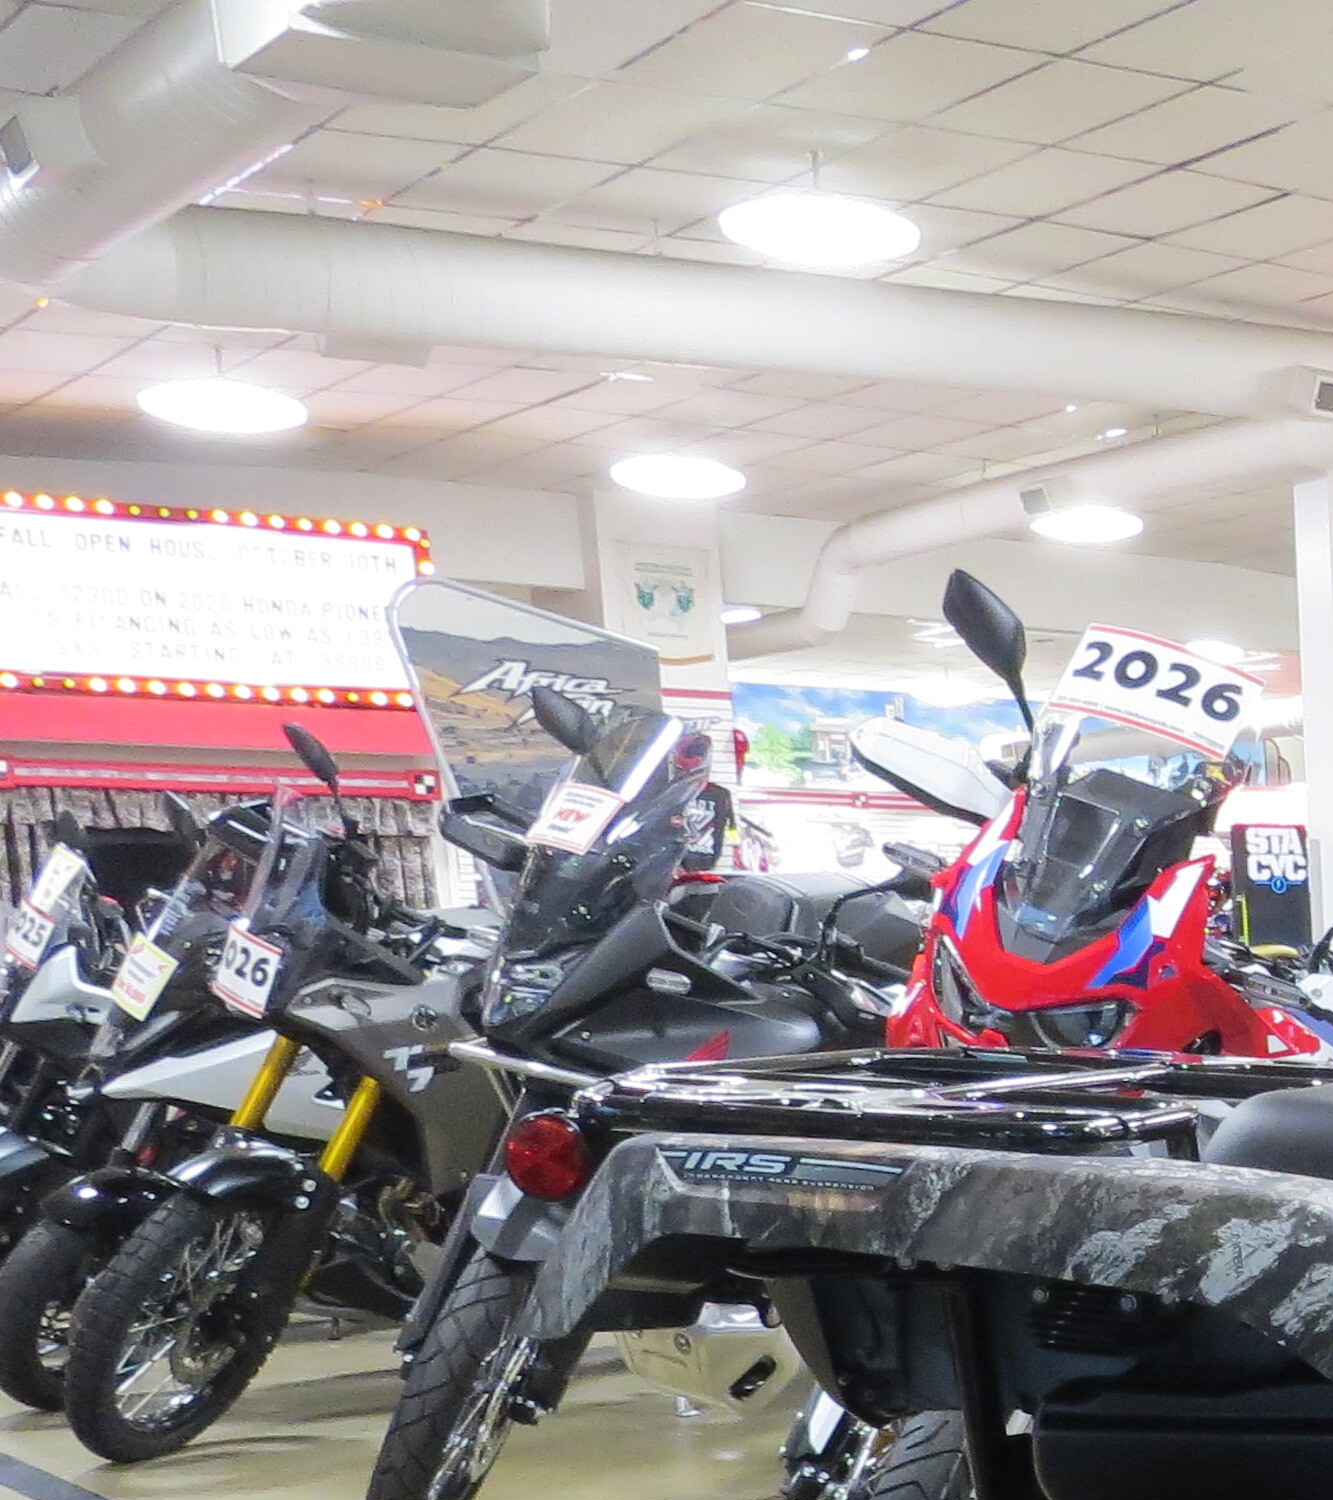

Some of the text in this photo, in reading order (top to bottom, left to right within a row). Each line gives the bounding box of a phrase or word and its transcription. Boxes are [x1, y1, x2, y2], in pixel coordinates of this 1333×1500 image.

[76, 532, 131, 555] OPEN
[149, 537, 216, 561] HOUS
[238, 545, 333, 570] OTOBER
[141, 589, 168, 608] ON
[243, 596, 312, 619] HONDA
[322, 601, 383, 624] PIONE
[75, 611, 197, 637] FIANCING
[210, 621, 238, 638] AS
[251, 623, 293, 642] LOW
[307, 627, 333, 645] AS
[129, 641, 242, 665] STARTING
[271, 650, 295, 668] AT
[453, 658, 637, 702] Africa
[1072, 640, 1244, 722] 2026
[1245, 826, 1304, 854] STA
[1246, 854, 1307, 881] CYC
[225, 938, 271, 988] 026
[683, 1152, 793, 1174] IRS
